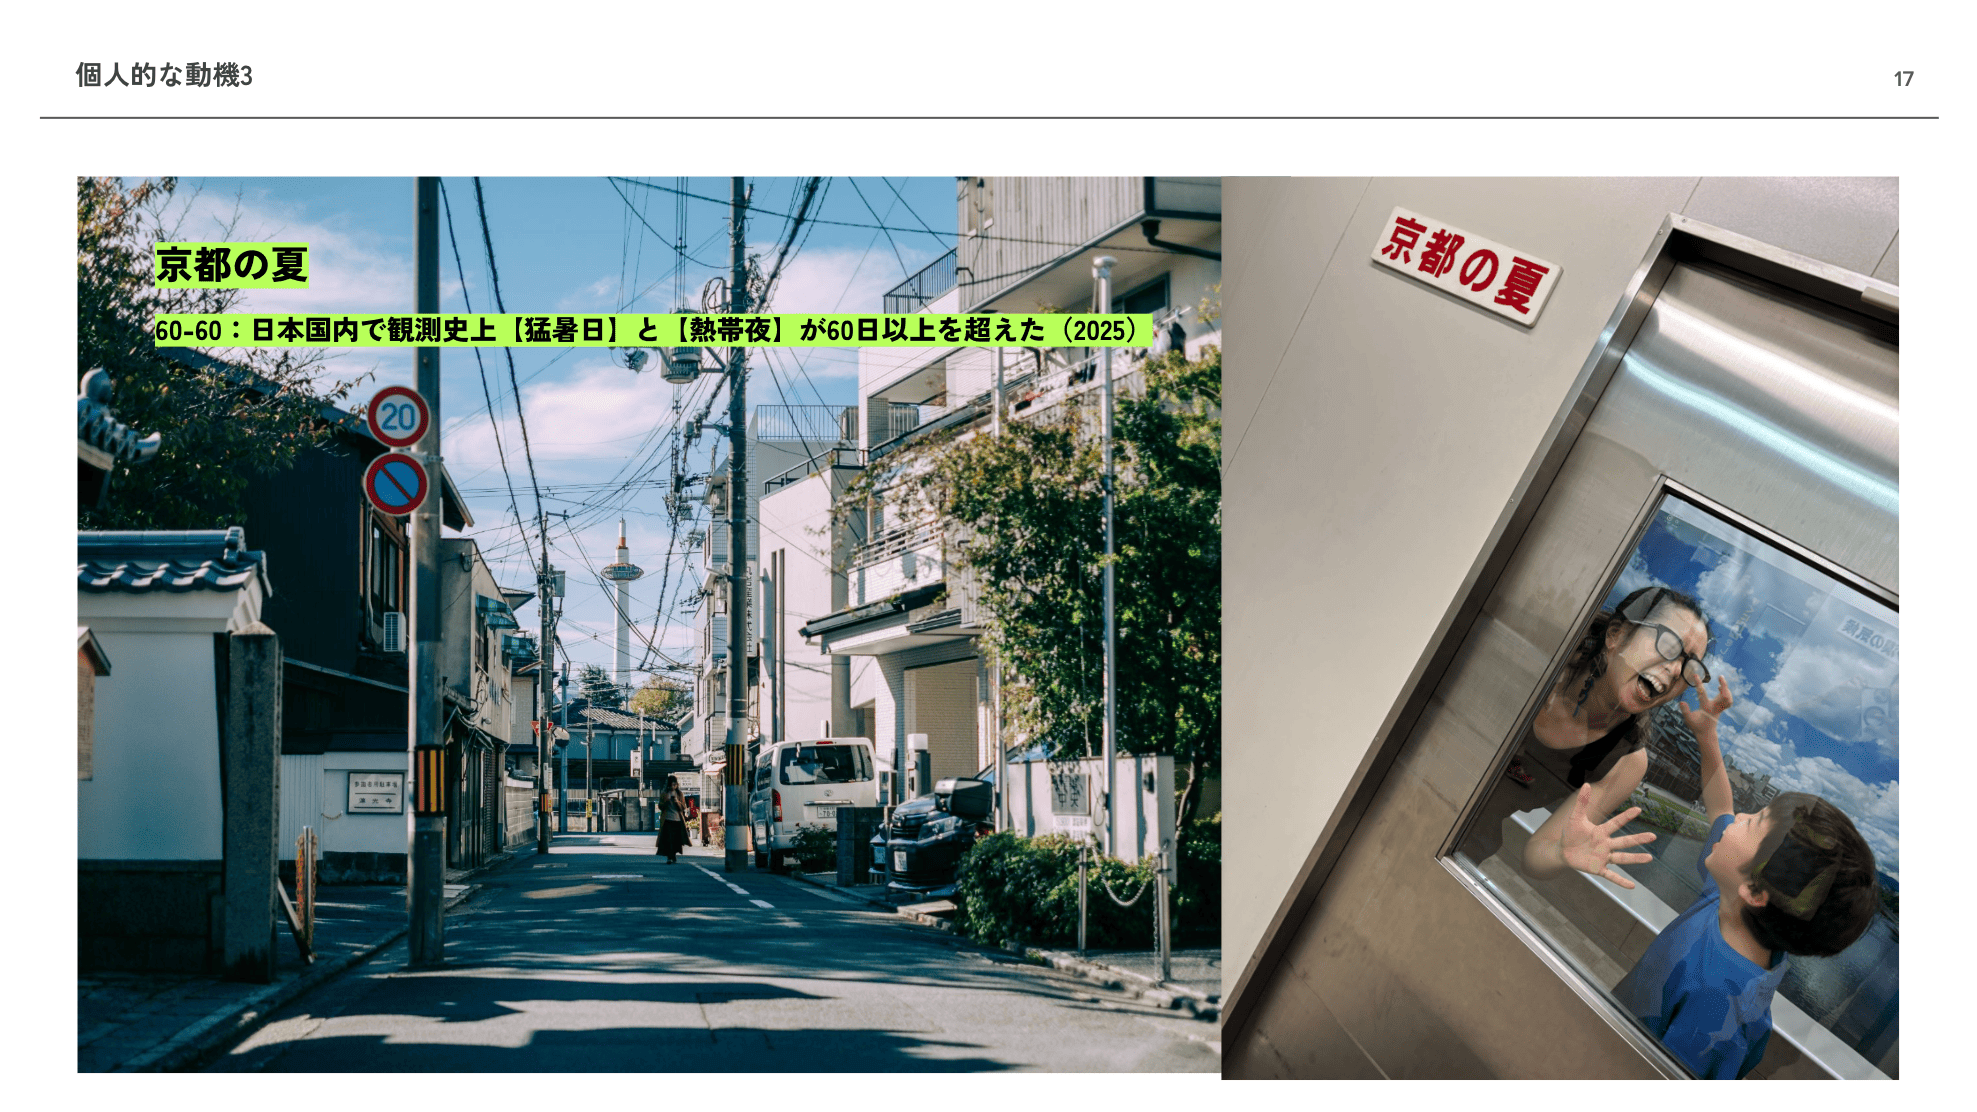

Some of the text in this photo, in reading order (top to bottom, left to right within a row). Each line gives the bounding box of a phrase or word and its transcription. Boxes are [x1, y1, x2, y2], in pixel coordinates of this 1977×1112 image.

[1380, 216, 1549, 315] 京都の夏
[381, 402, 416, 431] 20
